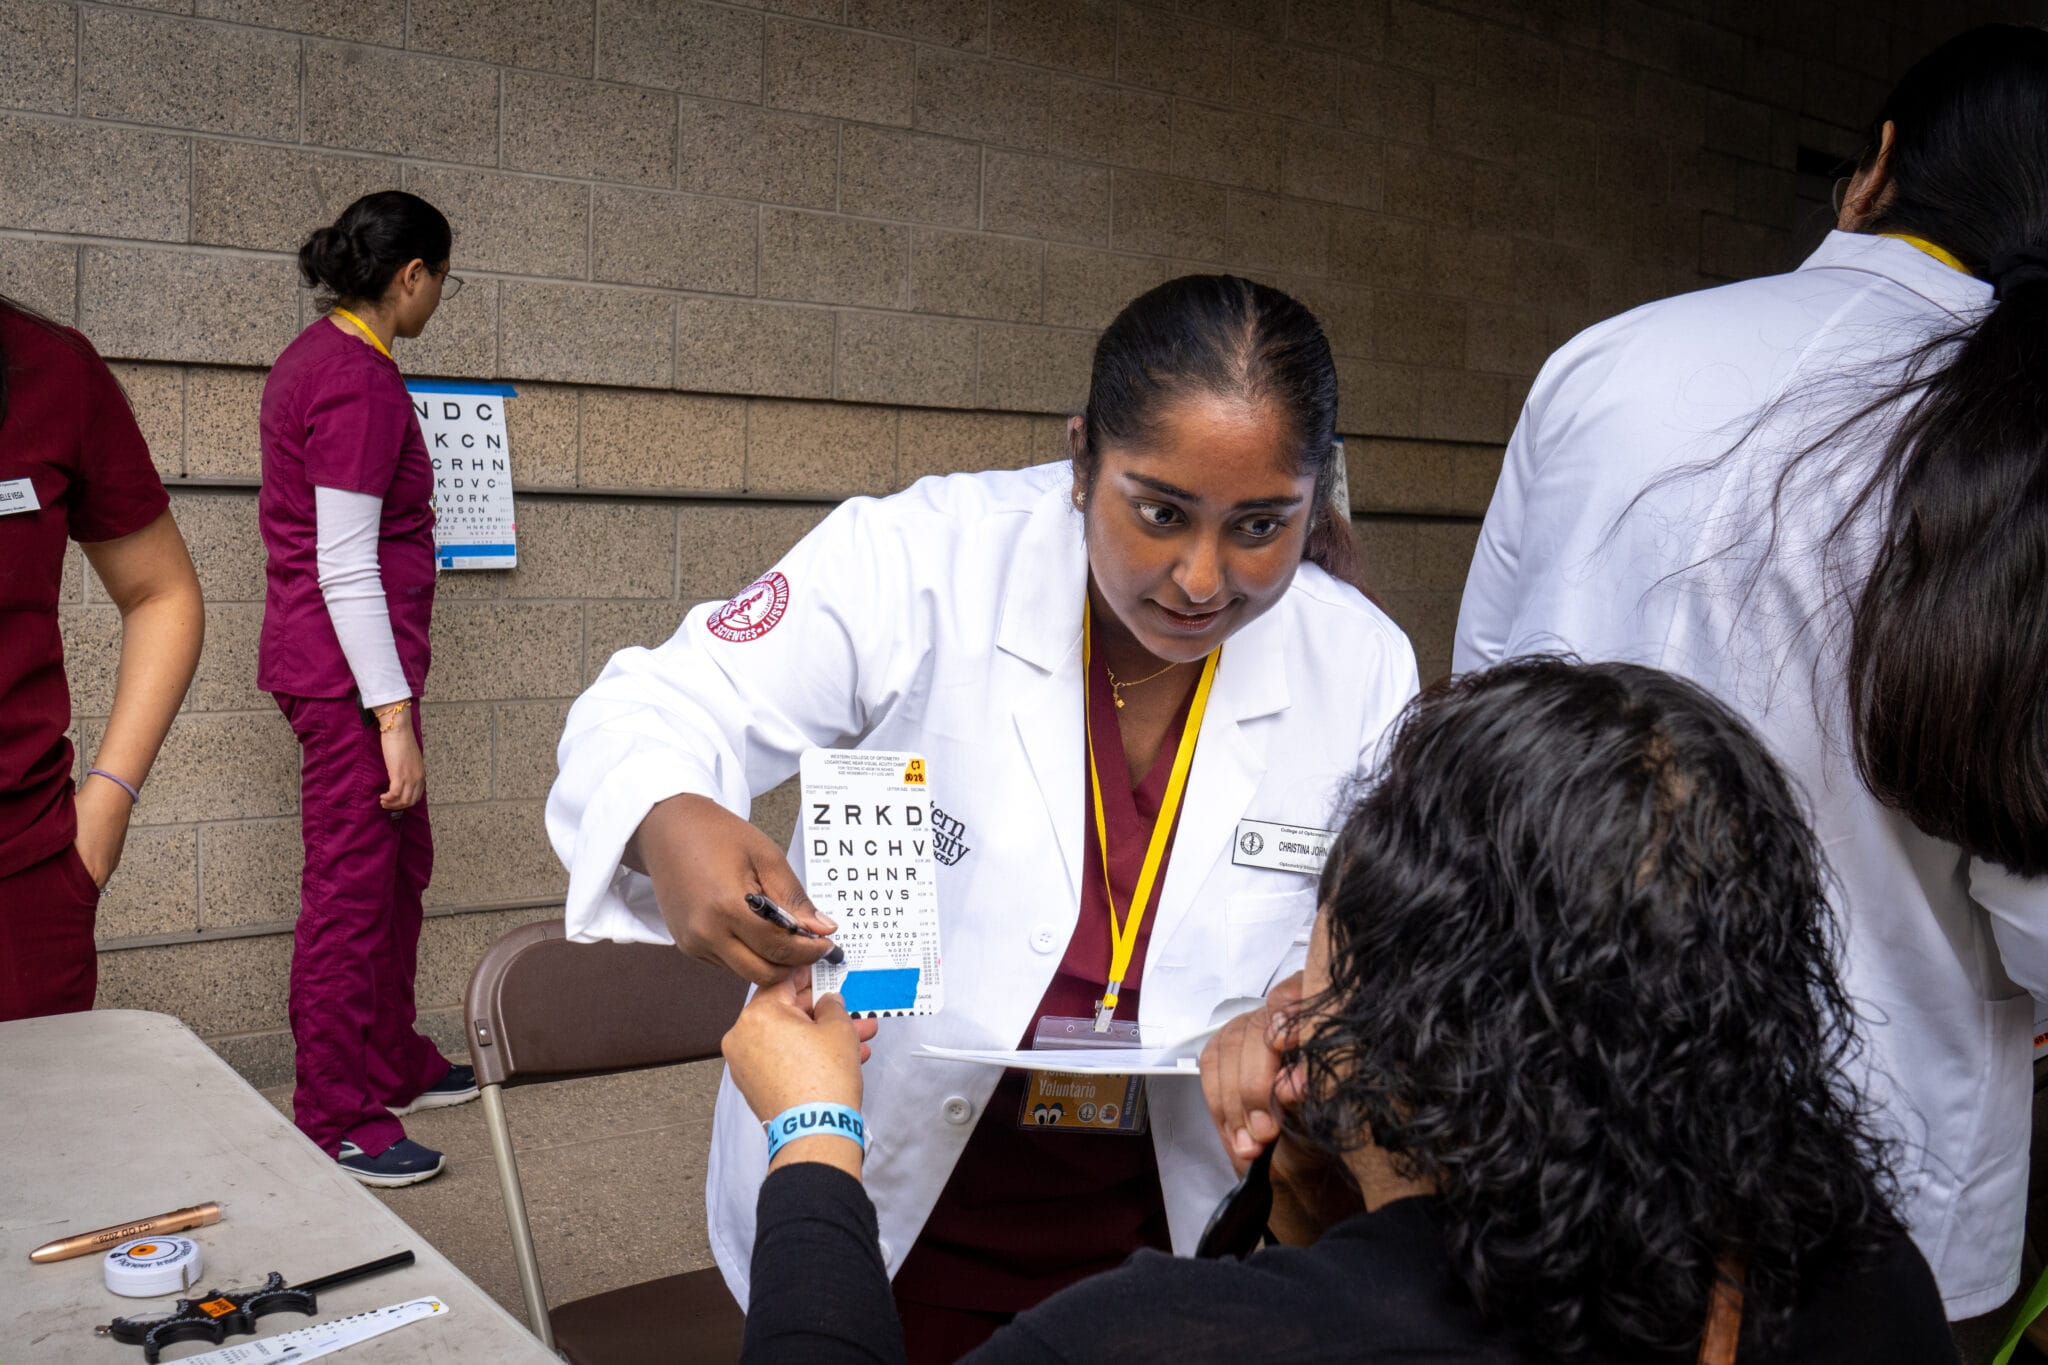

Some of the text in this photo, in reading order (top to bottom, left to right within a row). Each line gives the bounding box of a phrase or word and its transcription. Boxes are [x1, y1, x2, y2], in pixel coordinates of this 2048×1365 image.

[715, 625, 758, 641] SCIENCES
[1279, 841, 1309, 855] CHRISTINA
[1040, 1079, 1096, 1098] Voluntario
[783, 1111, 863, 1139] GUARD
